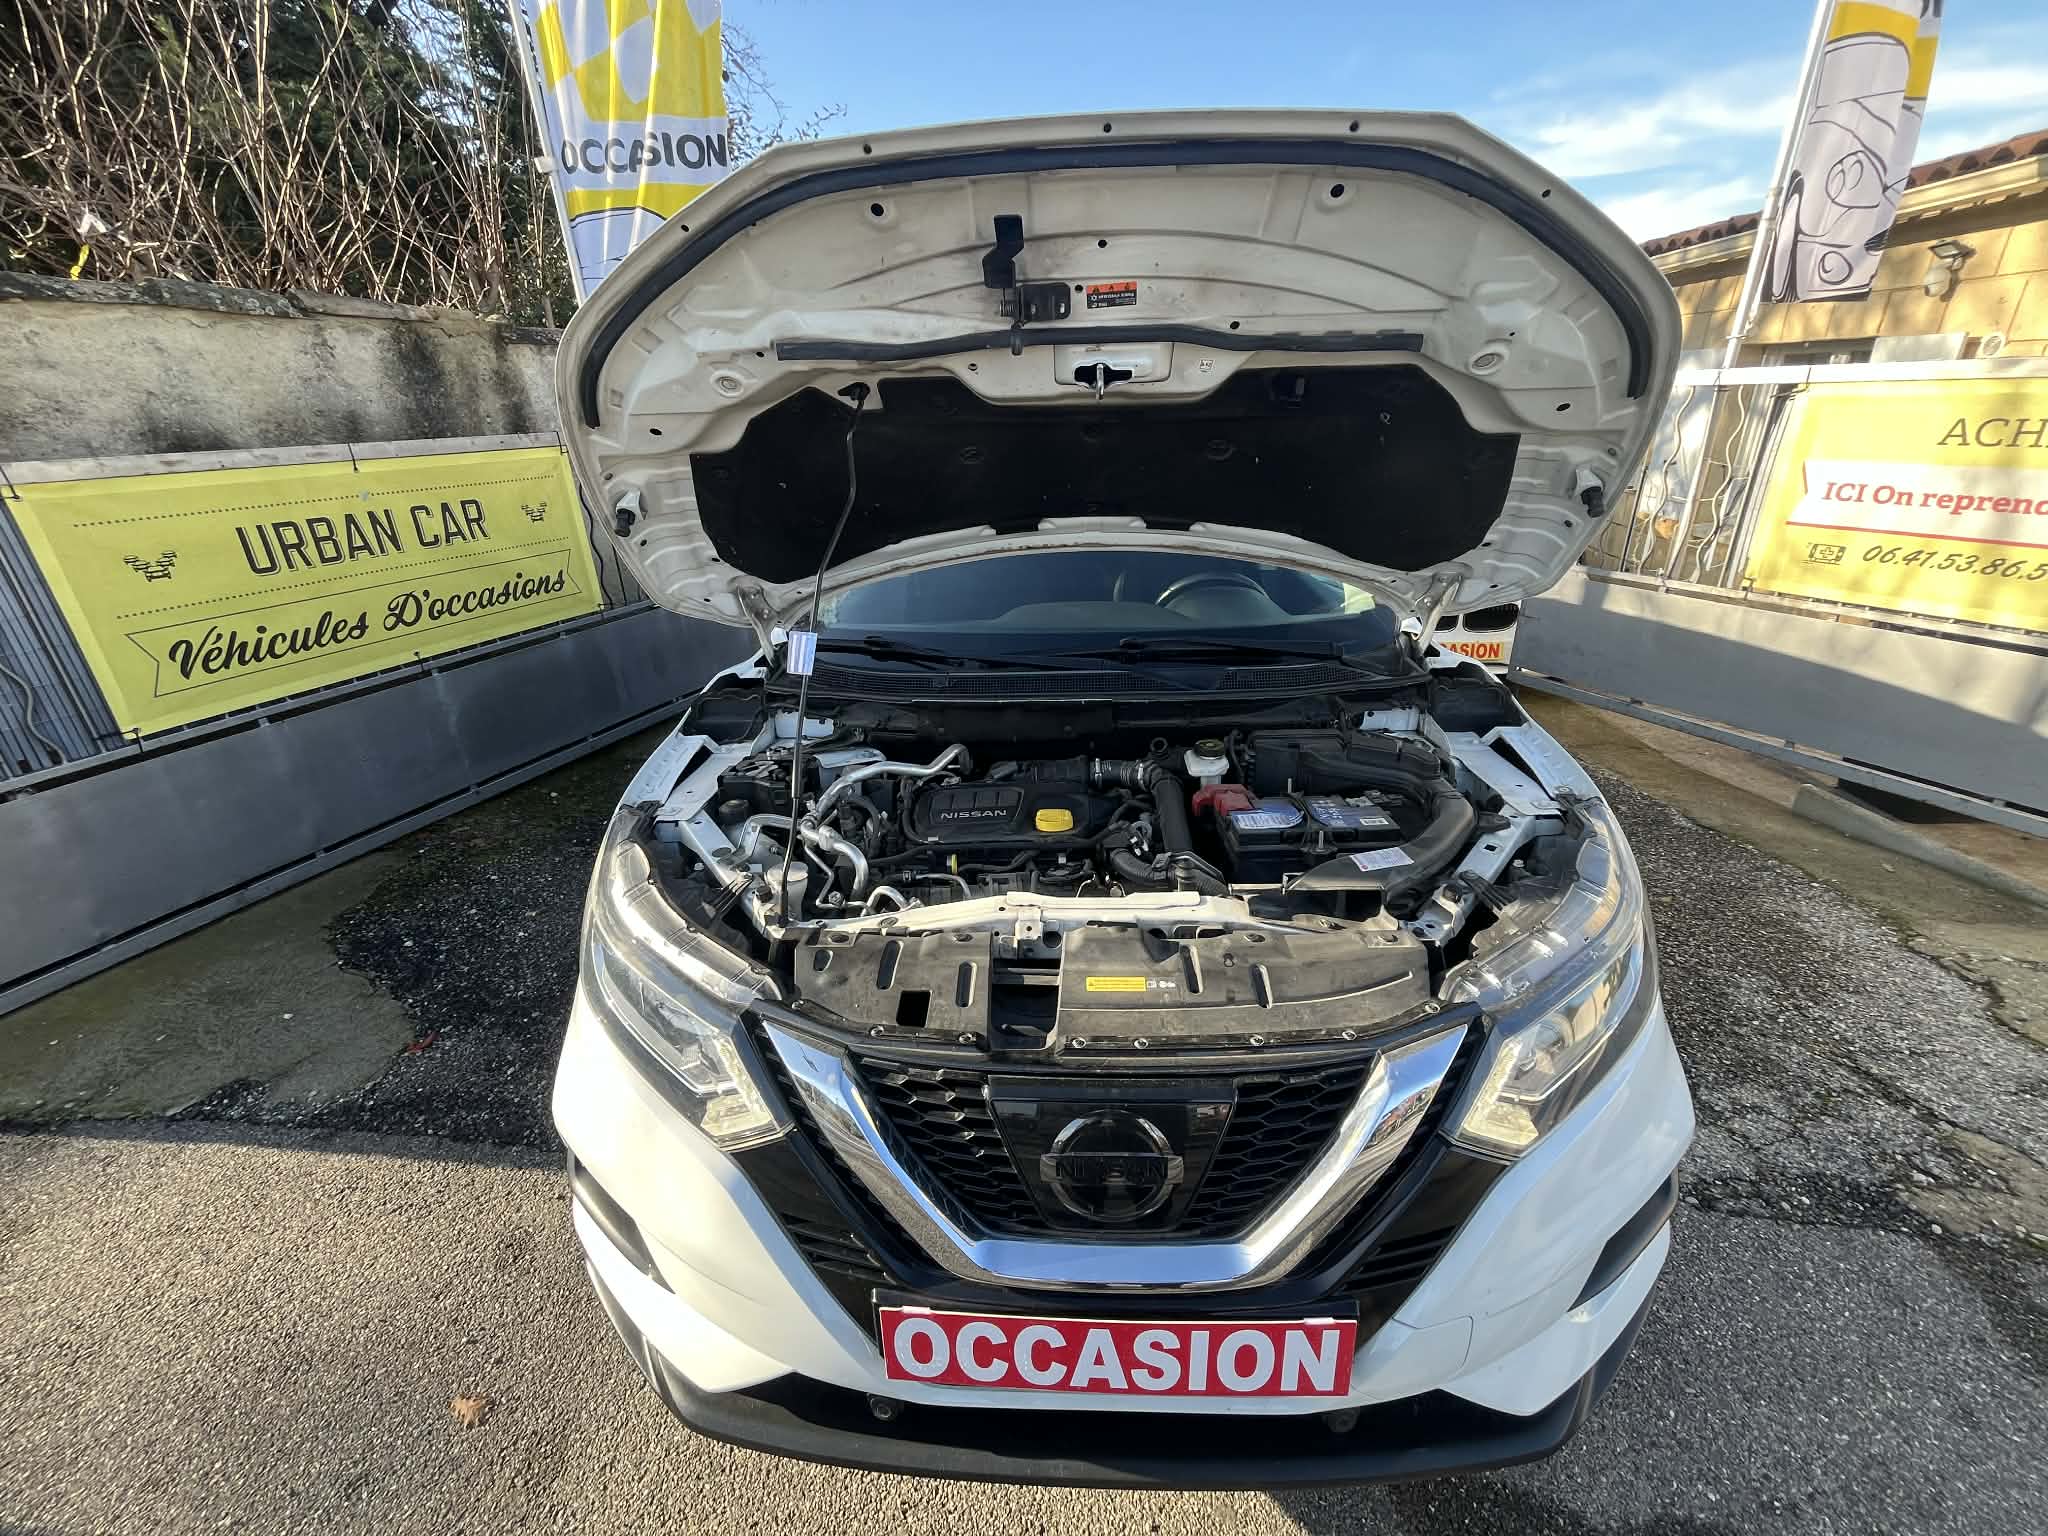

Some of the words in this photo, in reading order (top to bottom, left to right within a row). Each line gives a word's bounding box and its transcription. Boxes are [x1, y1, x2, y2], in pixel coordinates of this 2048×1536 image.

[561, 132, 727, 175] OCCASION
[1938, 417, 2048, 448] ACH
[1821, 481, 1868, 503] ICI
[1872, 485, 1914, 507] On
[235, 508, 405, 576] URBAN
[410, 498, 491, 549] CAR
[169, 611, 369, 680] Véhicules
[383, 569, 565, 632] D'occasions
[1440, 643, 1500, 659] ASION
[940, 809, 1007, 819] NISSAN
[894, 1317, 1341, 1392] OCCASION
